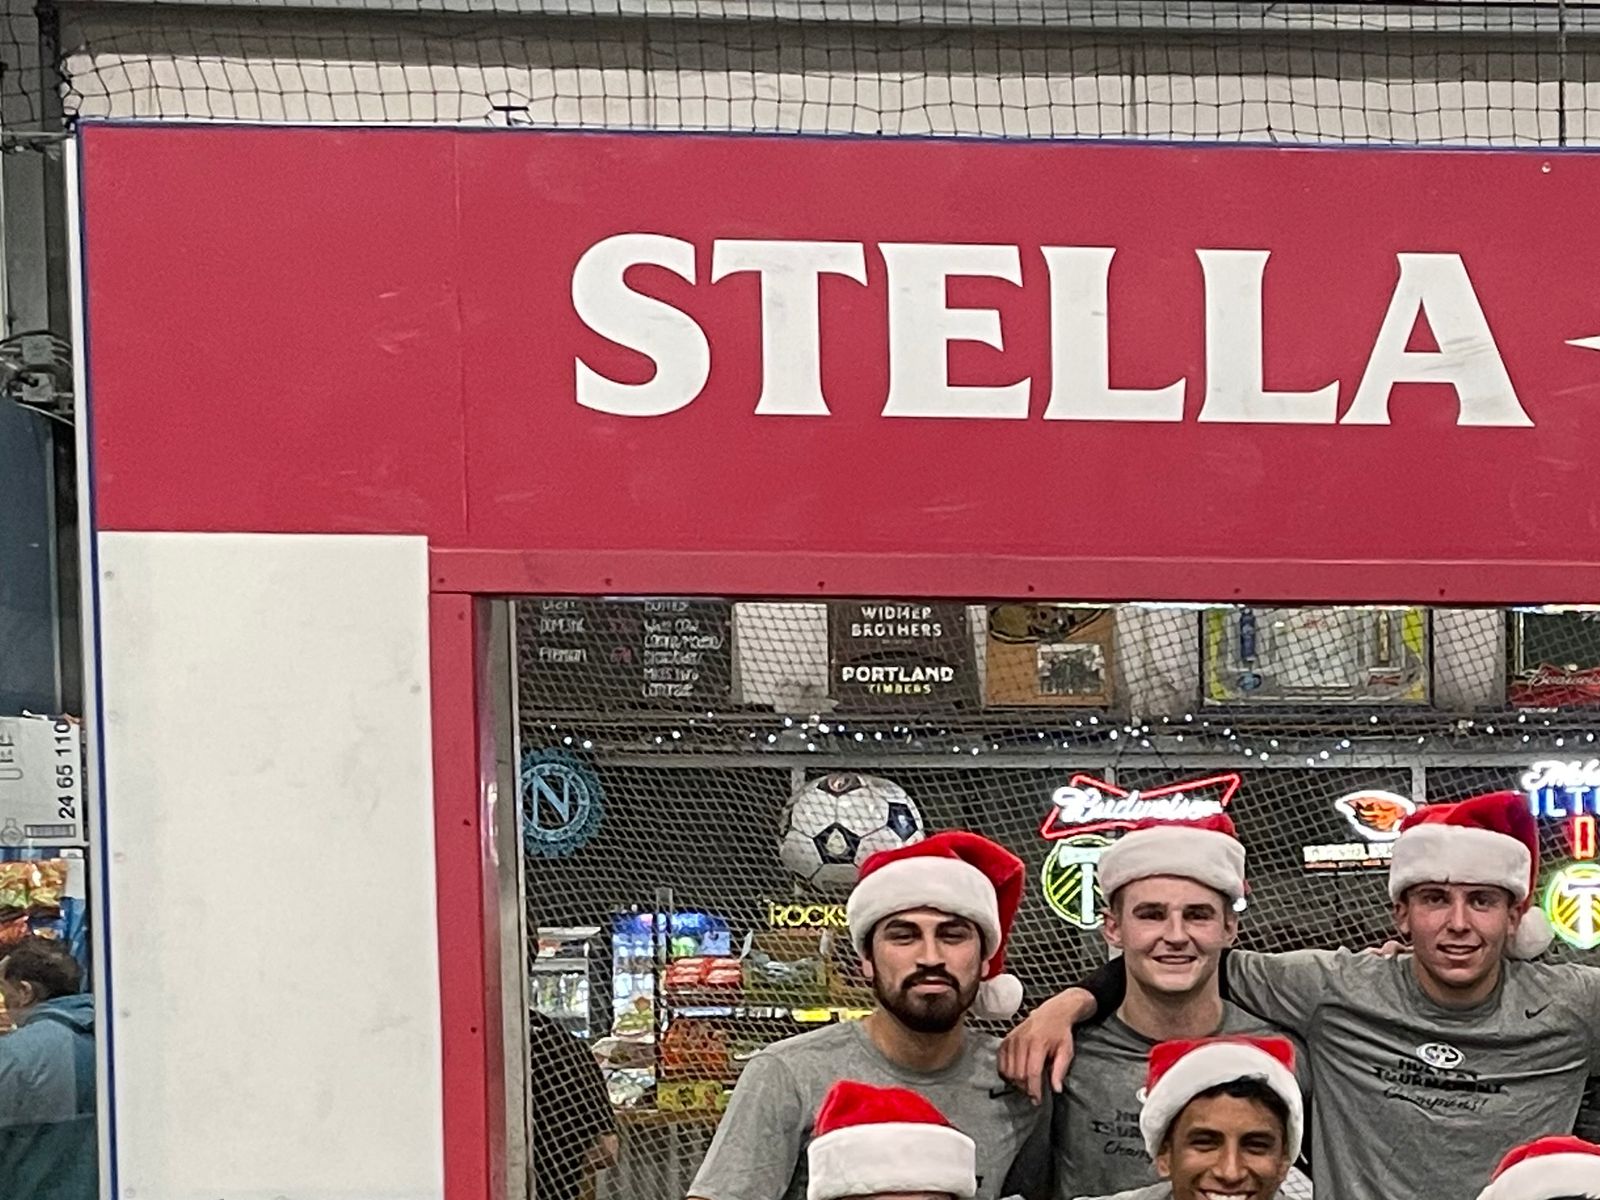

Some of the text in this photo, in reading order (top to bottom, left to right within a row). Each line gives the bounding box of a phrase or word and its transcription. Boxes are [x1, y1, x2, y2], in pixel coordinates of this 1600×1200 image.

[570, 233, 1535, 428] STELLA
[851, 623, 942, 637] BROTHERS
[842, 666, 954, 682] PORTLAND
[56, 764, 74, 788] 65
[58, 795, 76, 819] 24
